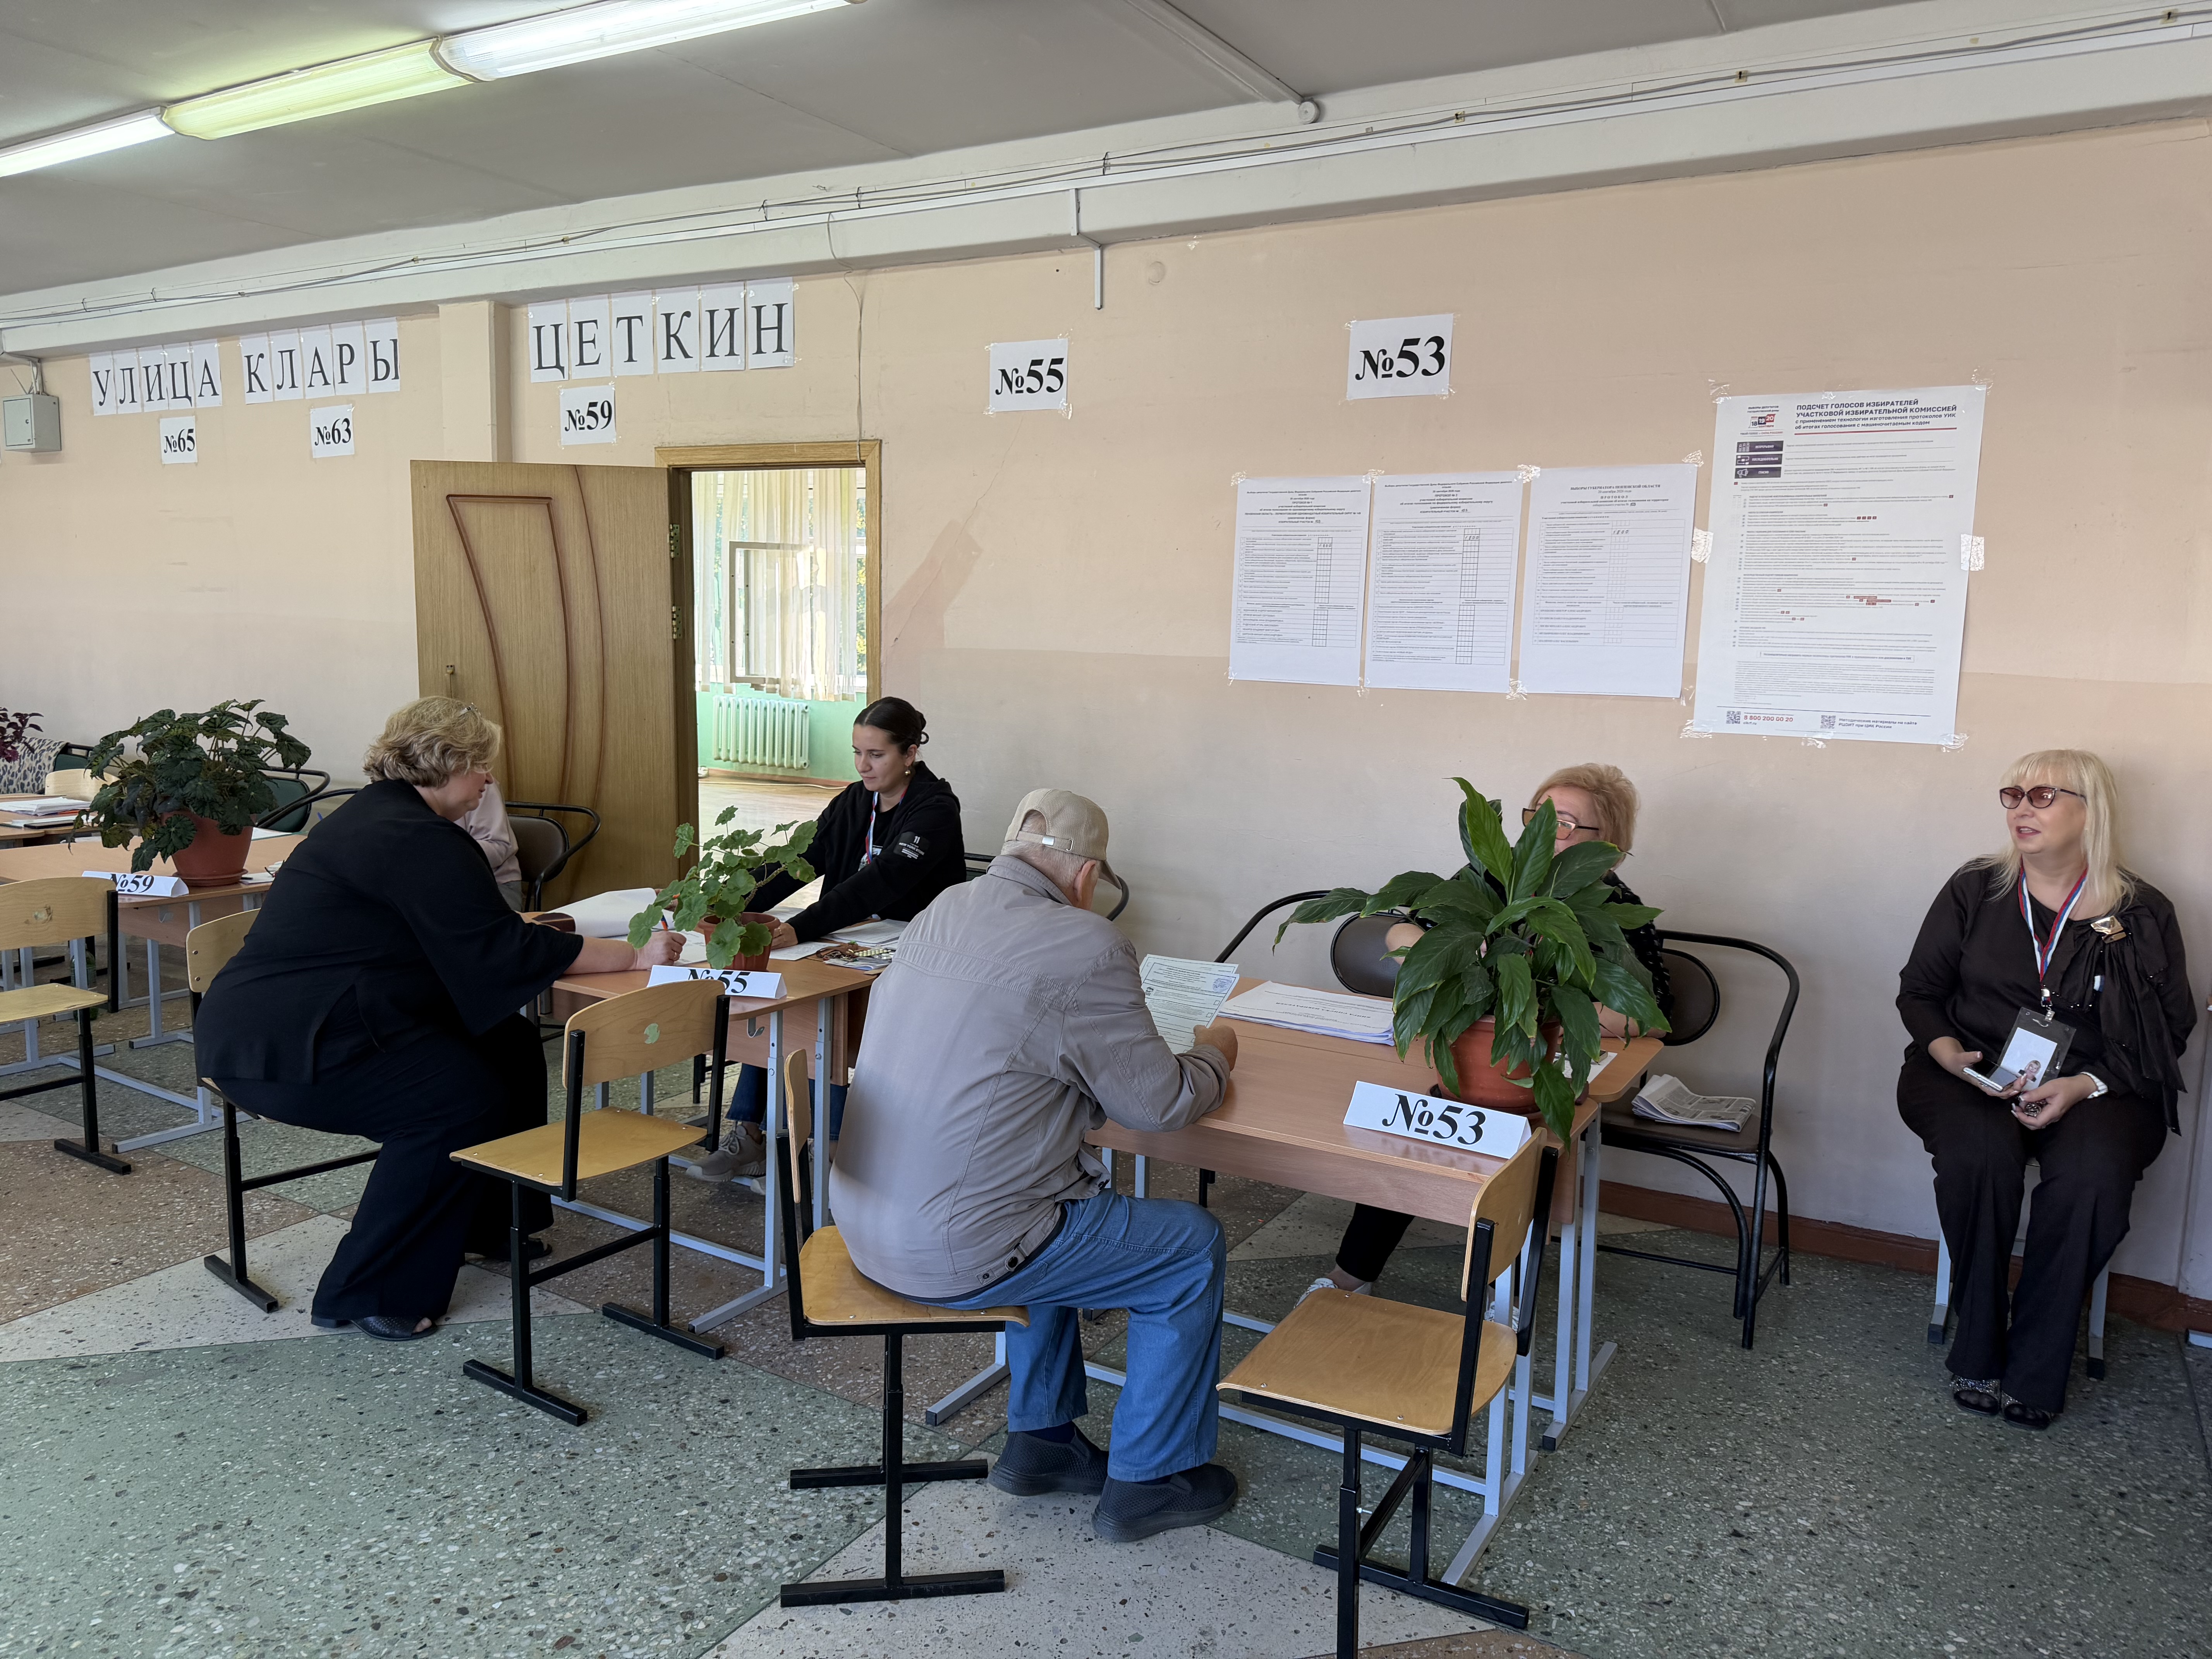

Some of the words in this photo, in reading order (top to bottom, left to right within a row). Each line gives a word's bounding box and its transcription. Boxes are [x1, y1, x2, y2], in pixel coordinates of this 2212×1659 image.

[93, 359, 220, 407] УЛИЦА
[244, 338, 400, 393] КЛАРЫ
[532, 302, 788, 380] ЦЕТКИН
[1355, 335, 1445, 381] №53
[995, 357, 1065, 395] №55
[564, 400, 613, 432] №59
[1796, 409, 1844, 418] УЧАСТКОВОЙ
[1845, 407, 1908, 416] ИЗБИРАТЕЛЬНОЙ
[1909, 405, 1957, 413] КОМИССИЕЙ
[1866, 398, 1918, 407] ИЗБИРАТЕЛЕЙ
[163, 428, 196, 453] №65
[314, 417, 352, 446] №63
[1381, 1093, 1486, 1145] №53
